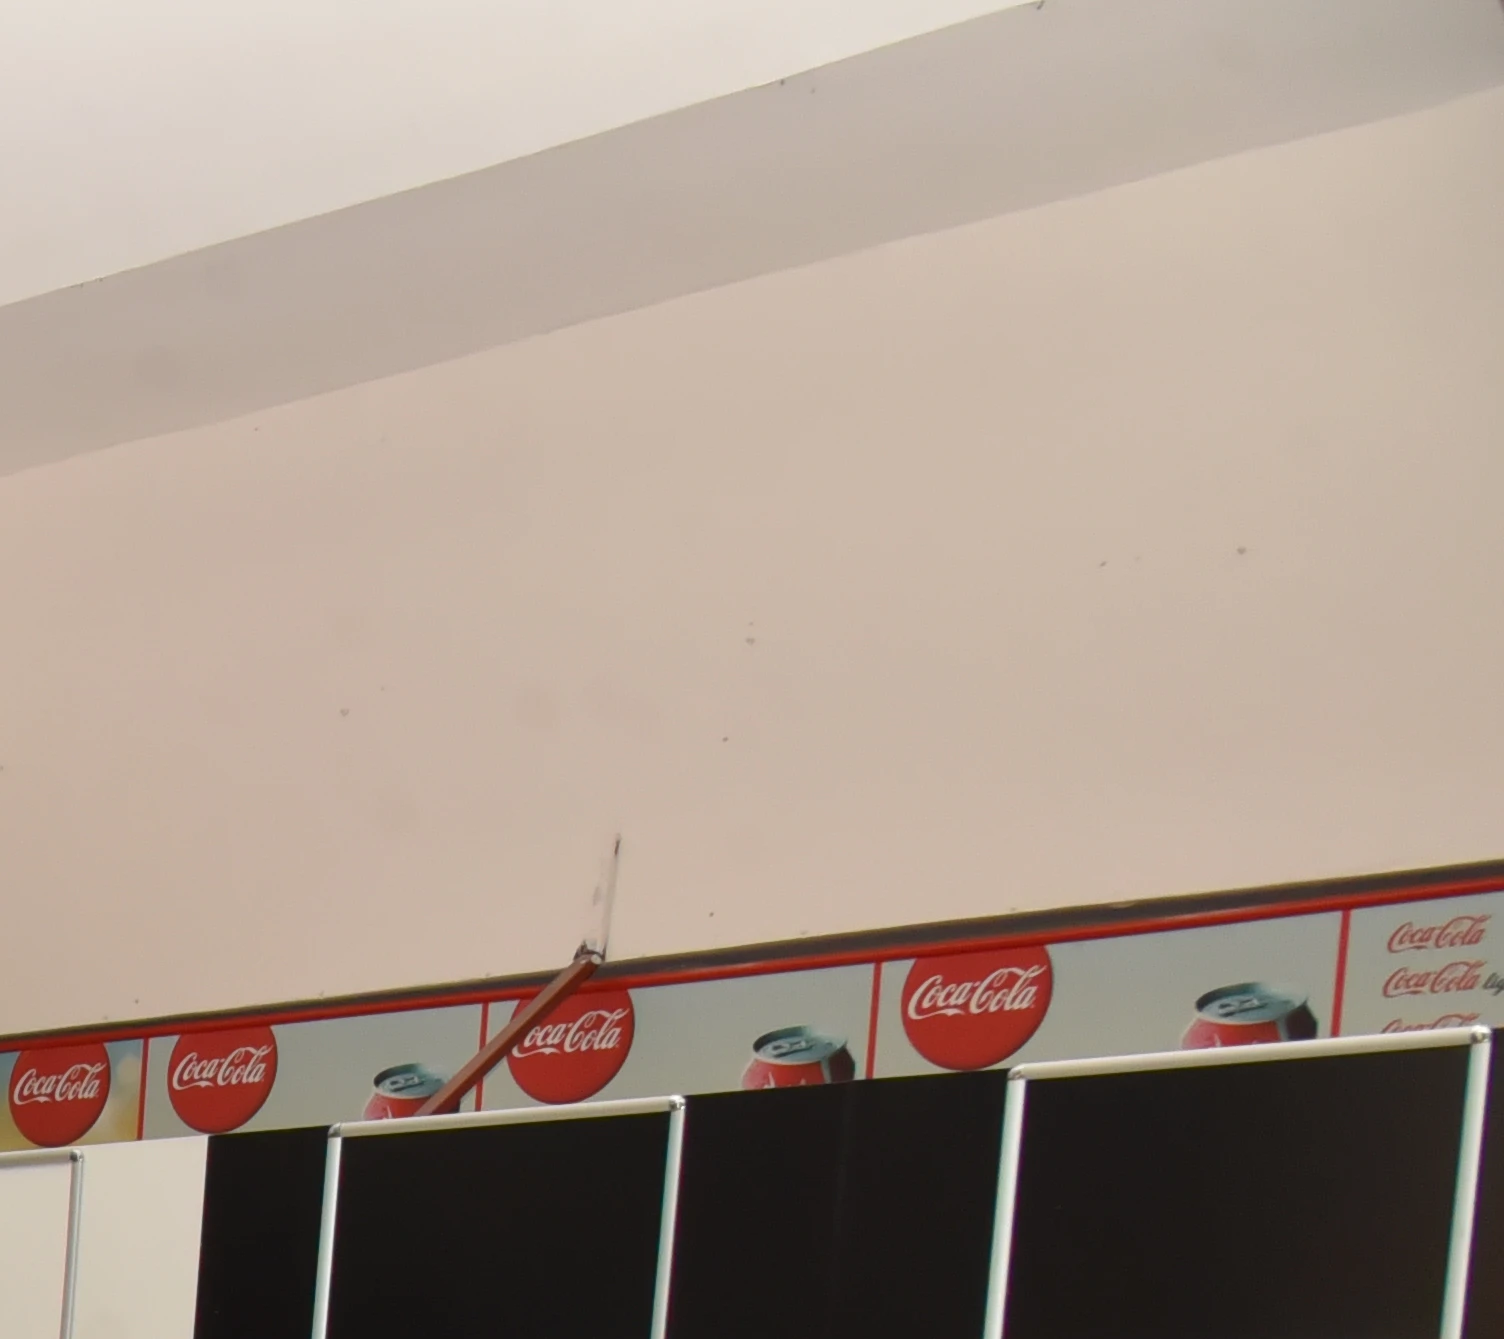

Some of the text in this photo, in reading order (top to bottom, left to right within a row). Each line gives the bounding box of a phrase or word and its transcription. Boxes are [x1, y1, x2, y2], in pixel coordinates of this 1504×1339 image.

[1386, 914, 1493, 954] Coca-Cola
[907, 963, 1048, 1022] Coca-Cola
[1381, 959, 1488, 998] Coca-Cola
[510, 1005, 631, 1059] oca-Cola
[11, 1060, 108, 1108] Coca-Cola
[171, 1043, 276, 1091] Coca-Cola
